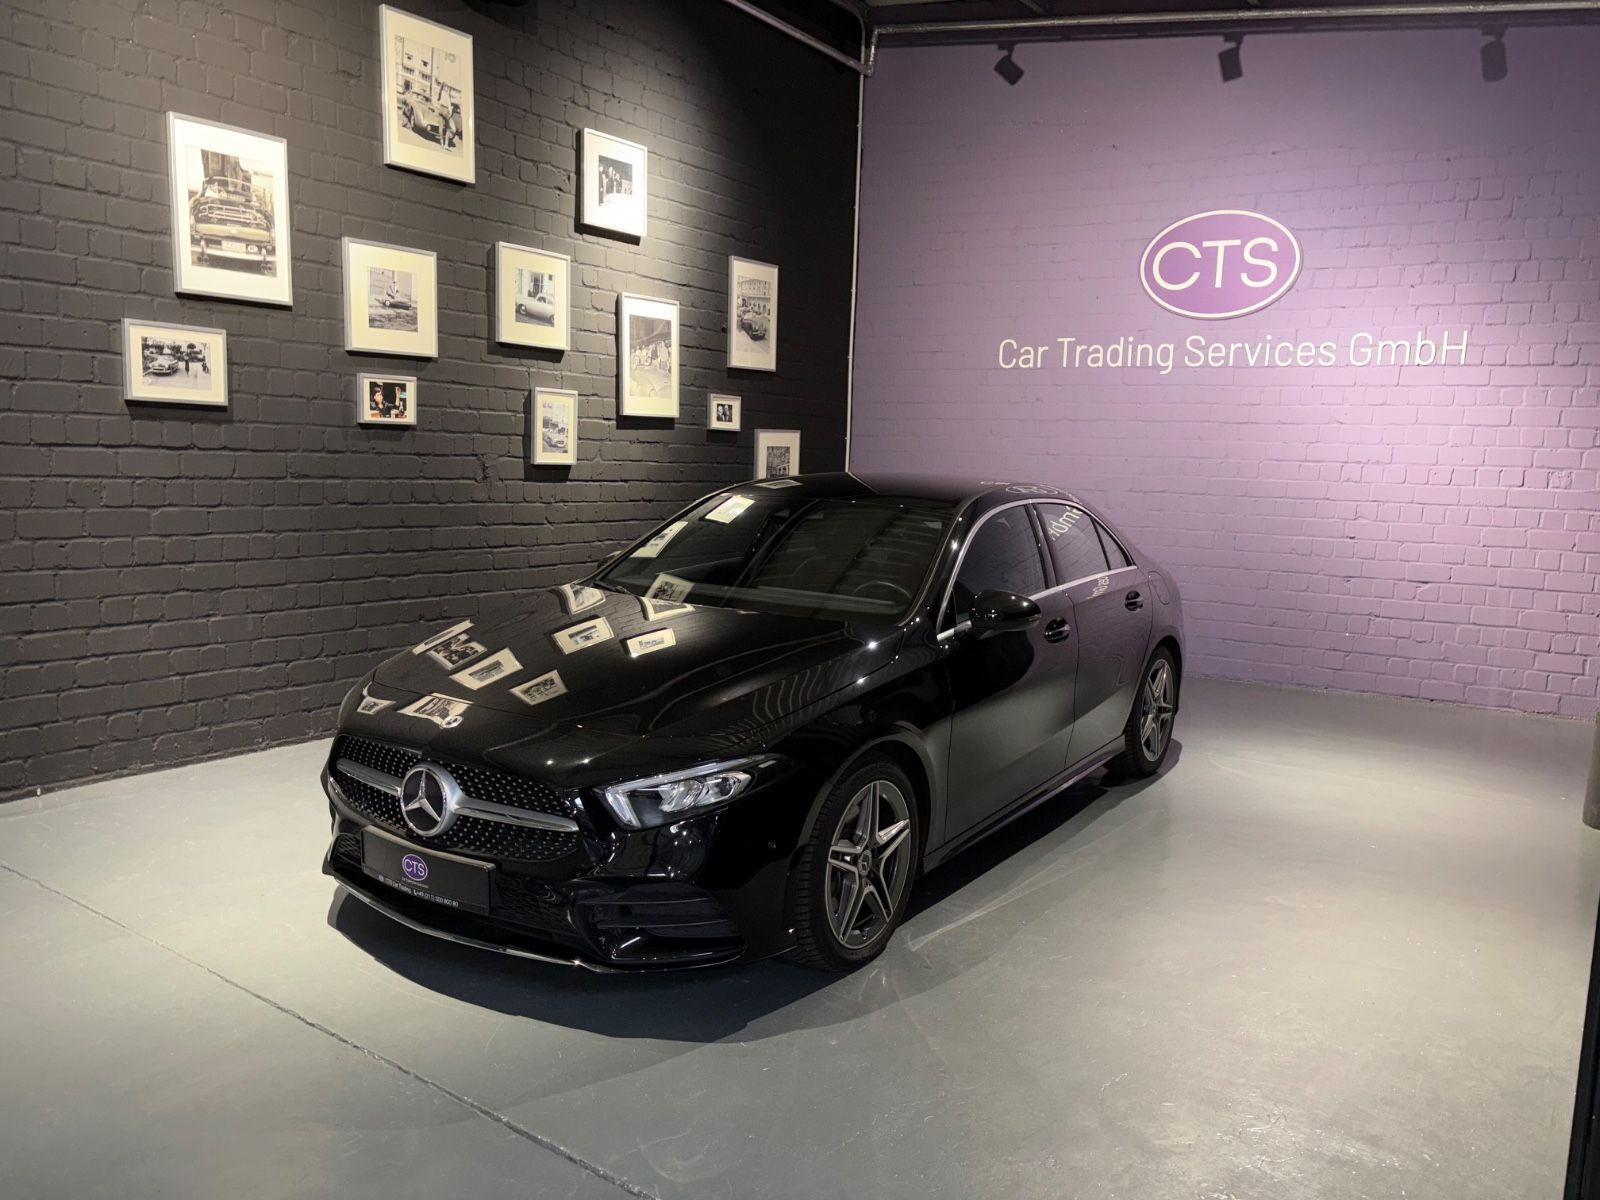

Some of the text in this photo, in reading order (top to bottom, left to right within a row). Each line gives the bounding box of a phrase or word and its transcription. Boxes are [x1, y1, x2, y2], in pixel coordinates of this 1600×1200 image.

[1152, 236, 1278, 290] CTS
[998, 330, 1469, 374] Car Trading Services GmbH
[404, 858, 425, 876] CTS
